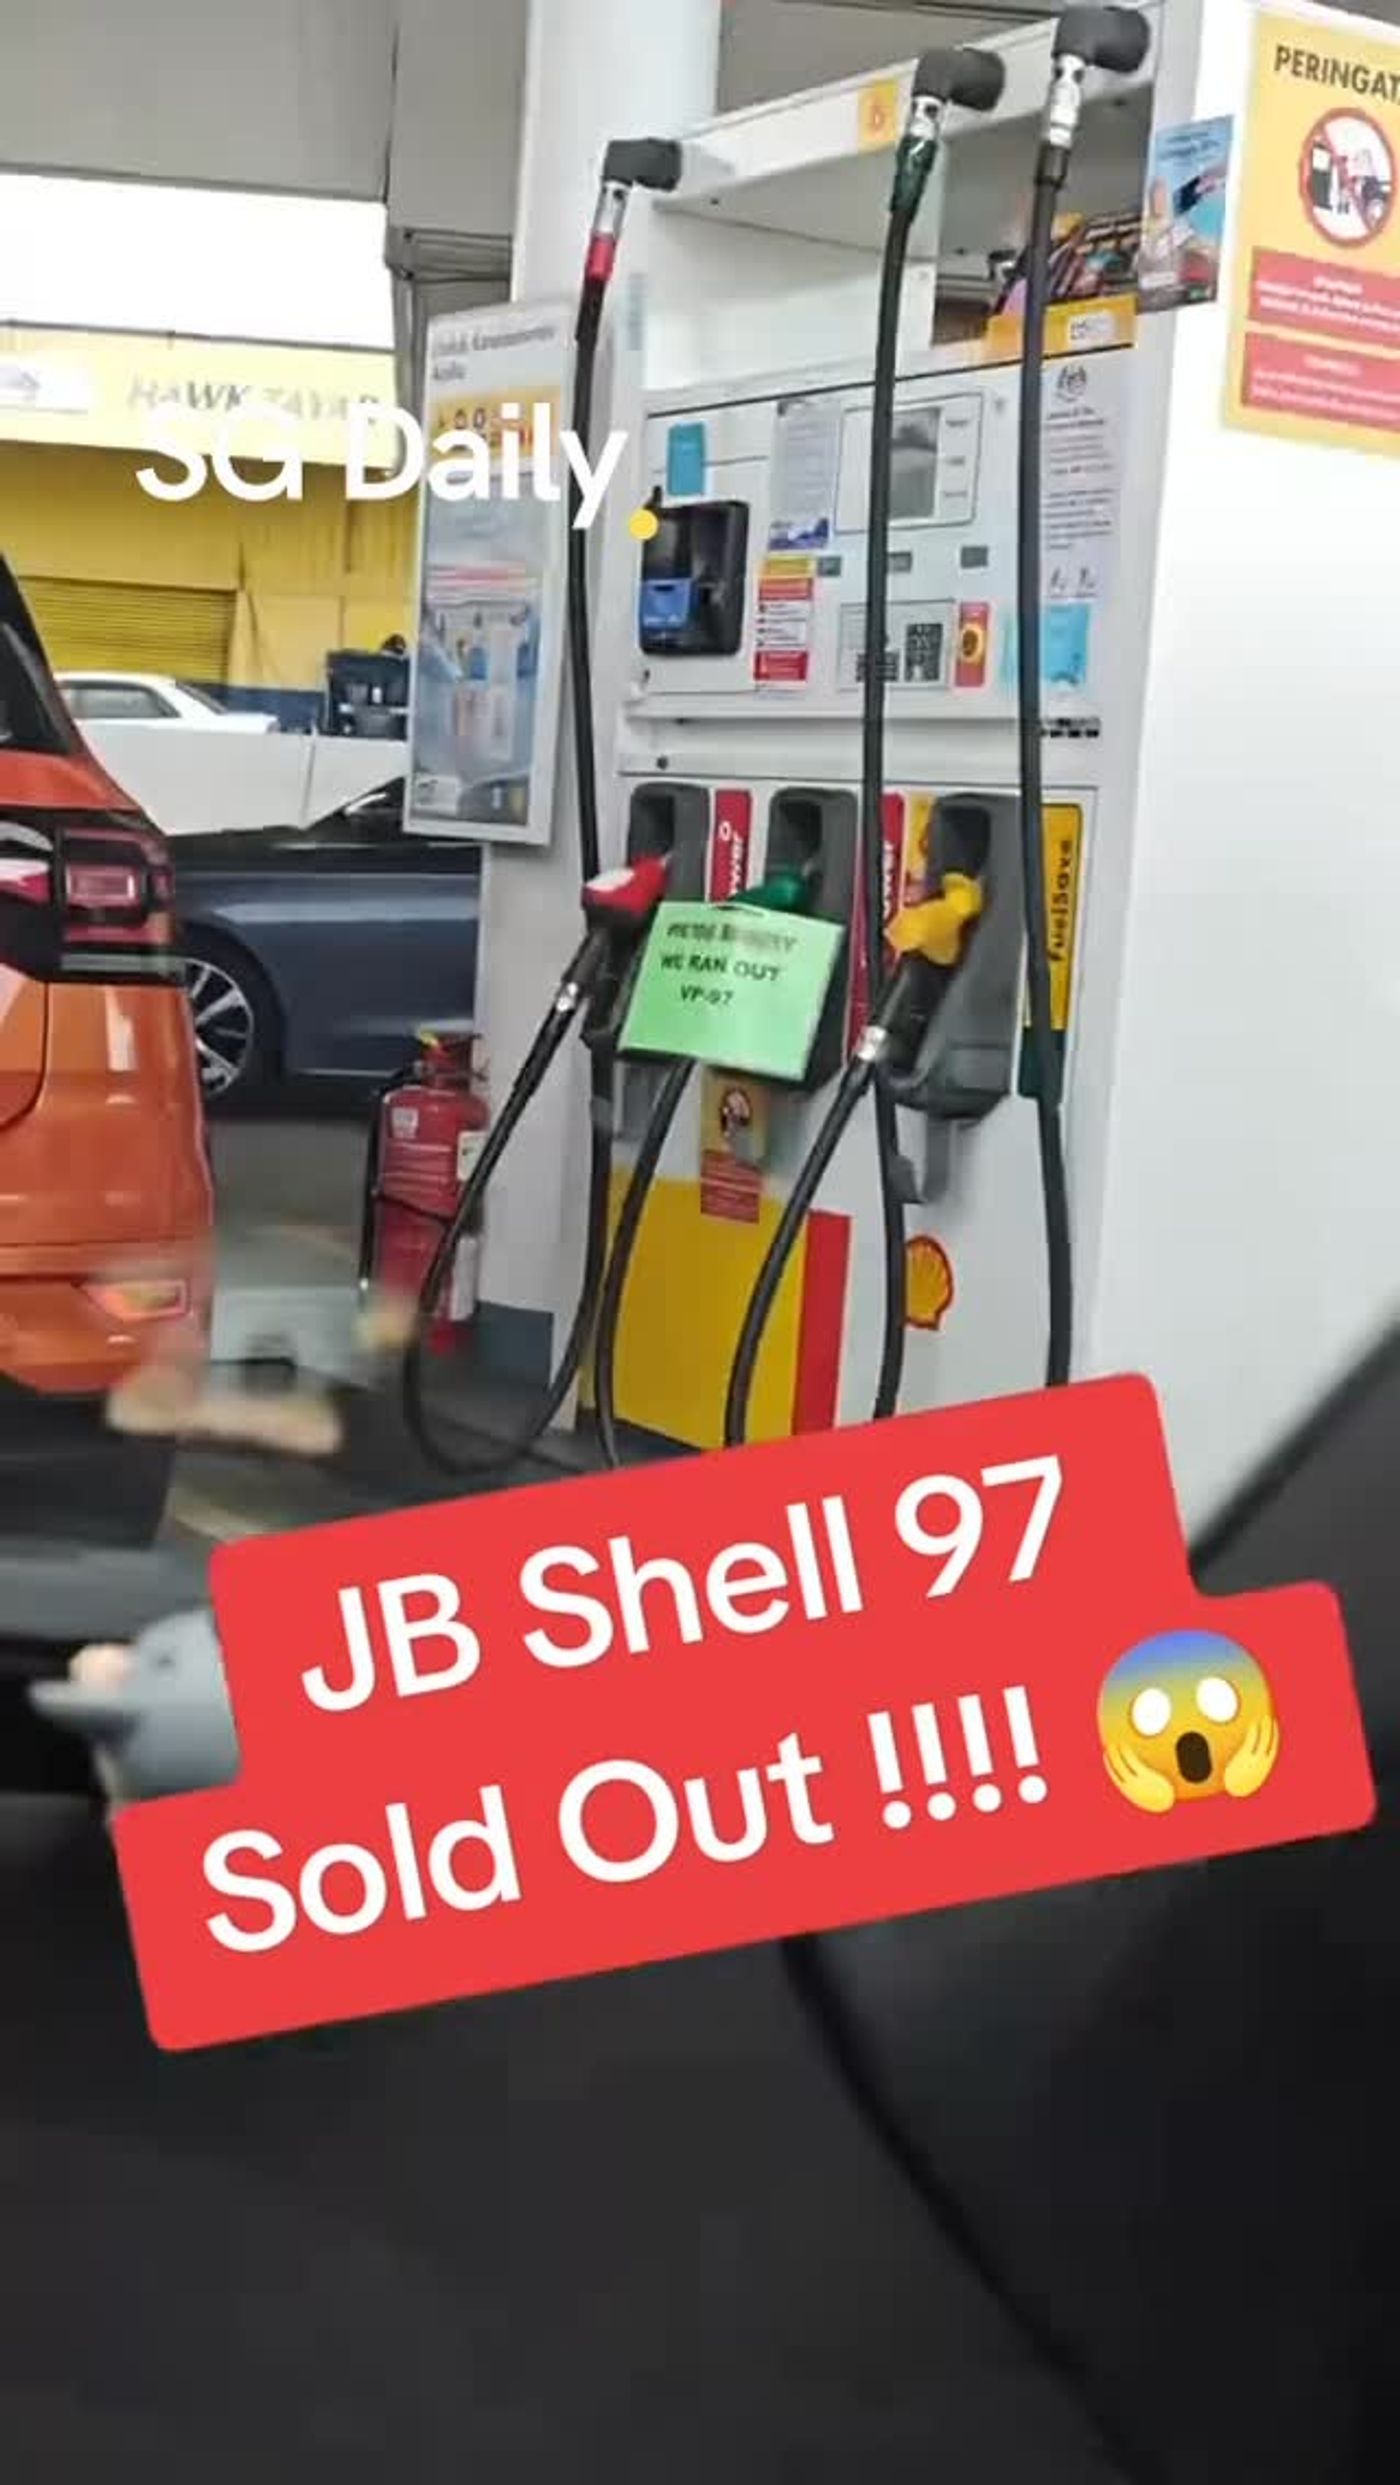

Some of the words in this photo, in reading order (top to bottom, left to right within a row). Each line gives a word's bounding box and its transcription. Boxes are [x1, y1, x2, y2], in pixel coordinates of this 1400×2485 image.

[1273, 43, 1400, 106] PERINGAT
[689, 953, 728, 974] RAN
[733, 960, 780, 981] OUT
